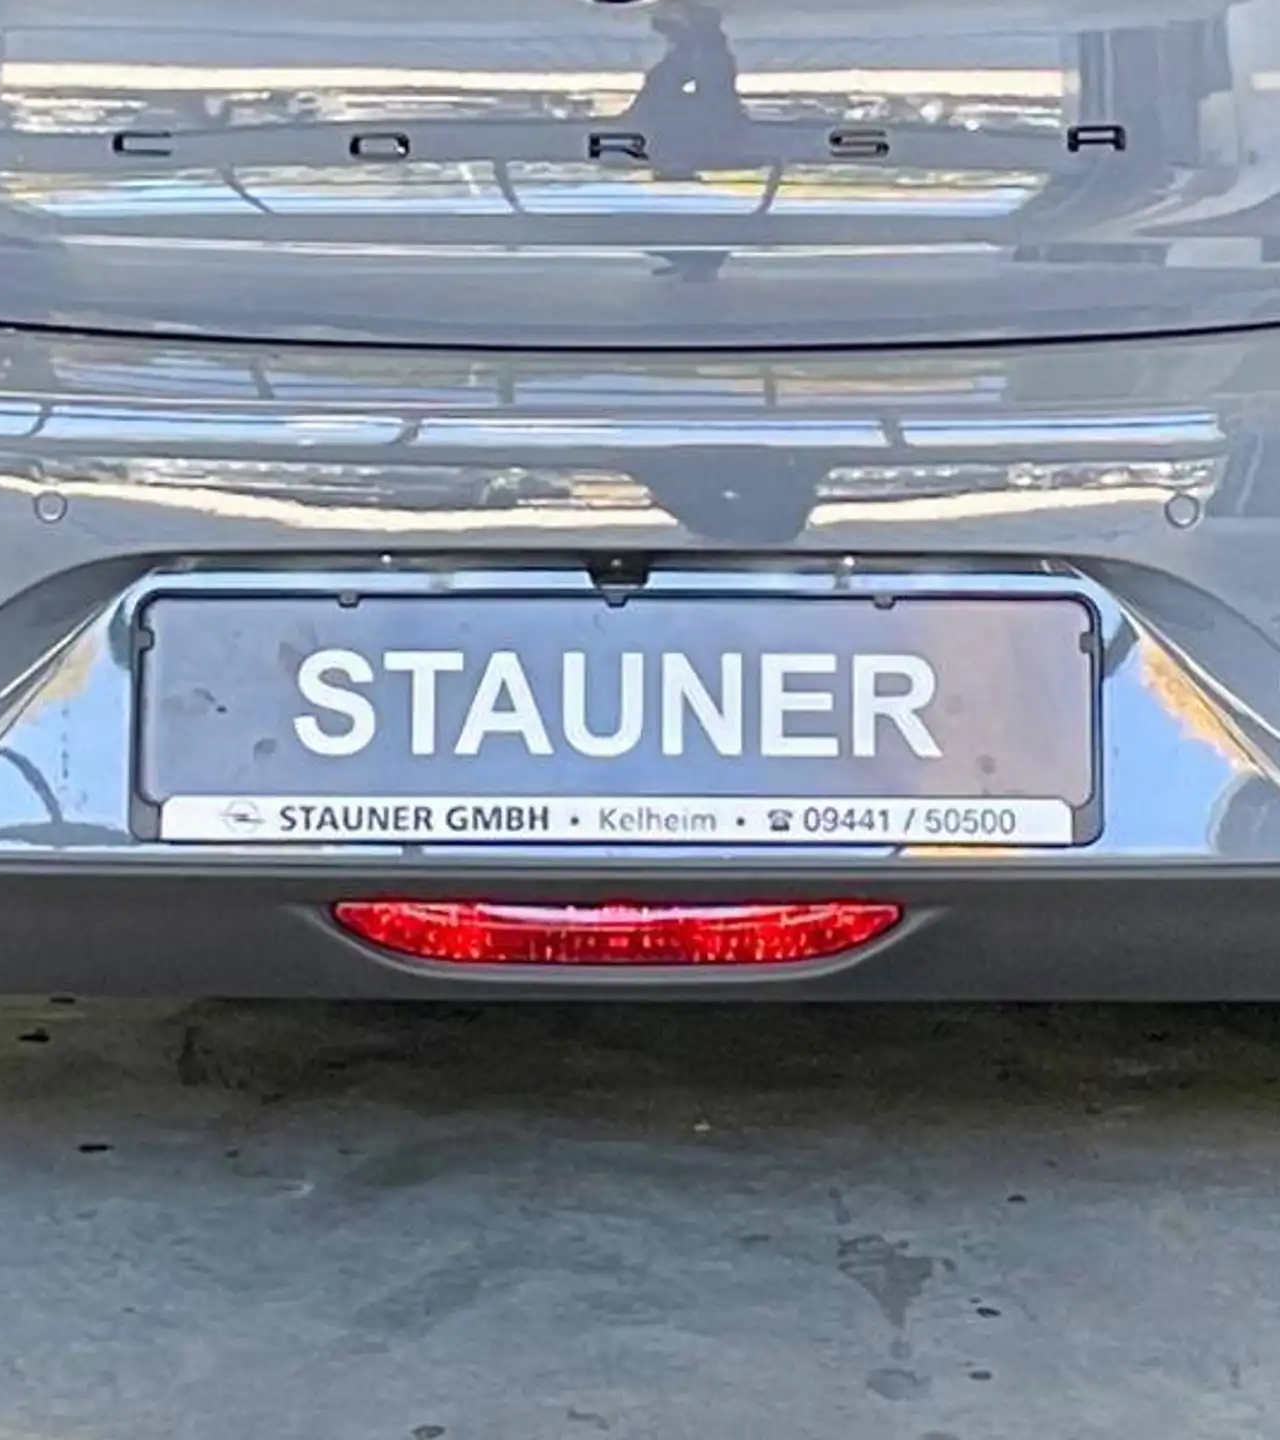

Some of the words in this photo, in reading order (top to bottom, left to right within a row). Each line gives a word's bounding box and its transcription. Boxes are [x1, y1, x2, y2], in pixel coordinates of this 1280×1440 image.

[113, 124, 1126, 160] CORSA
[293, 650, 942, 759] STAUNER
[279, 805, 433, 832] STAUNER
[446, 805, 549, 832] GMBH
[599, 807, 716, 832] Kelheim
[803, 806, 890, 834] 09441
[925, 807, 1017, 835] 50500
